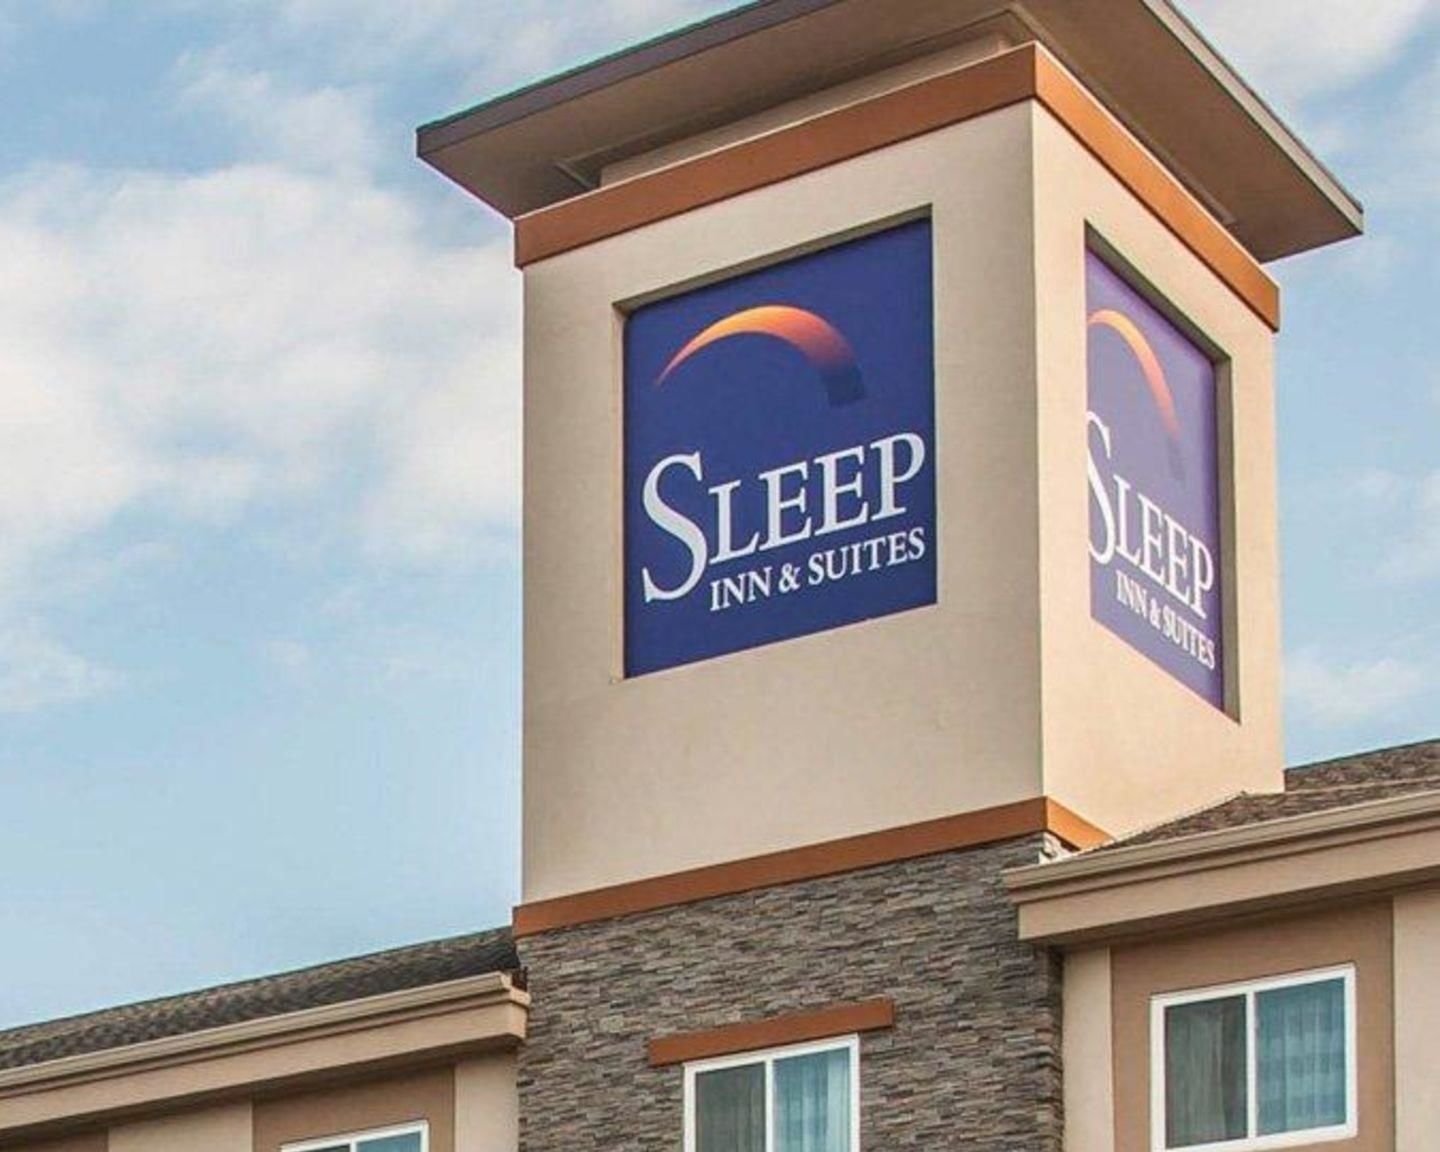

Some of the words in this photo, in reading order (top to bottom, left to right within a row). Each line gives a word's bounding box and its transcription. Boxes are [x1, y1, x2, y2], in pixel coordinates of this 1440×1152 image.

[642, 432, 926, 602] SLEEP
[710, 567, 773, 611] INN
[778, 562, 801, 593] &
[808, 527, 926, 585] SUITES
[1087, 411, 1215, 619] SLEEP
[1115, 570, 1148, 618] INN
[1150, 597, 1162, 629] &
[1162, 605, 1215, 670] SUITES
